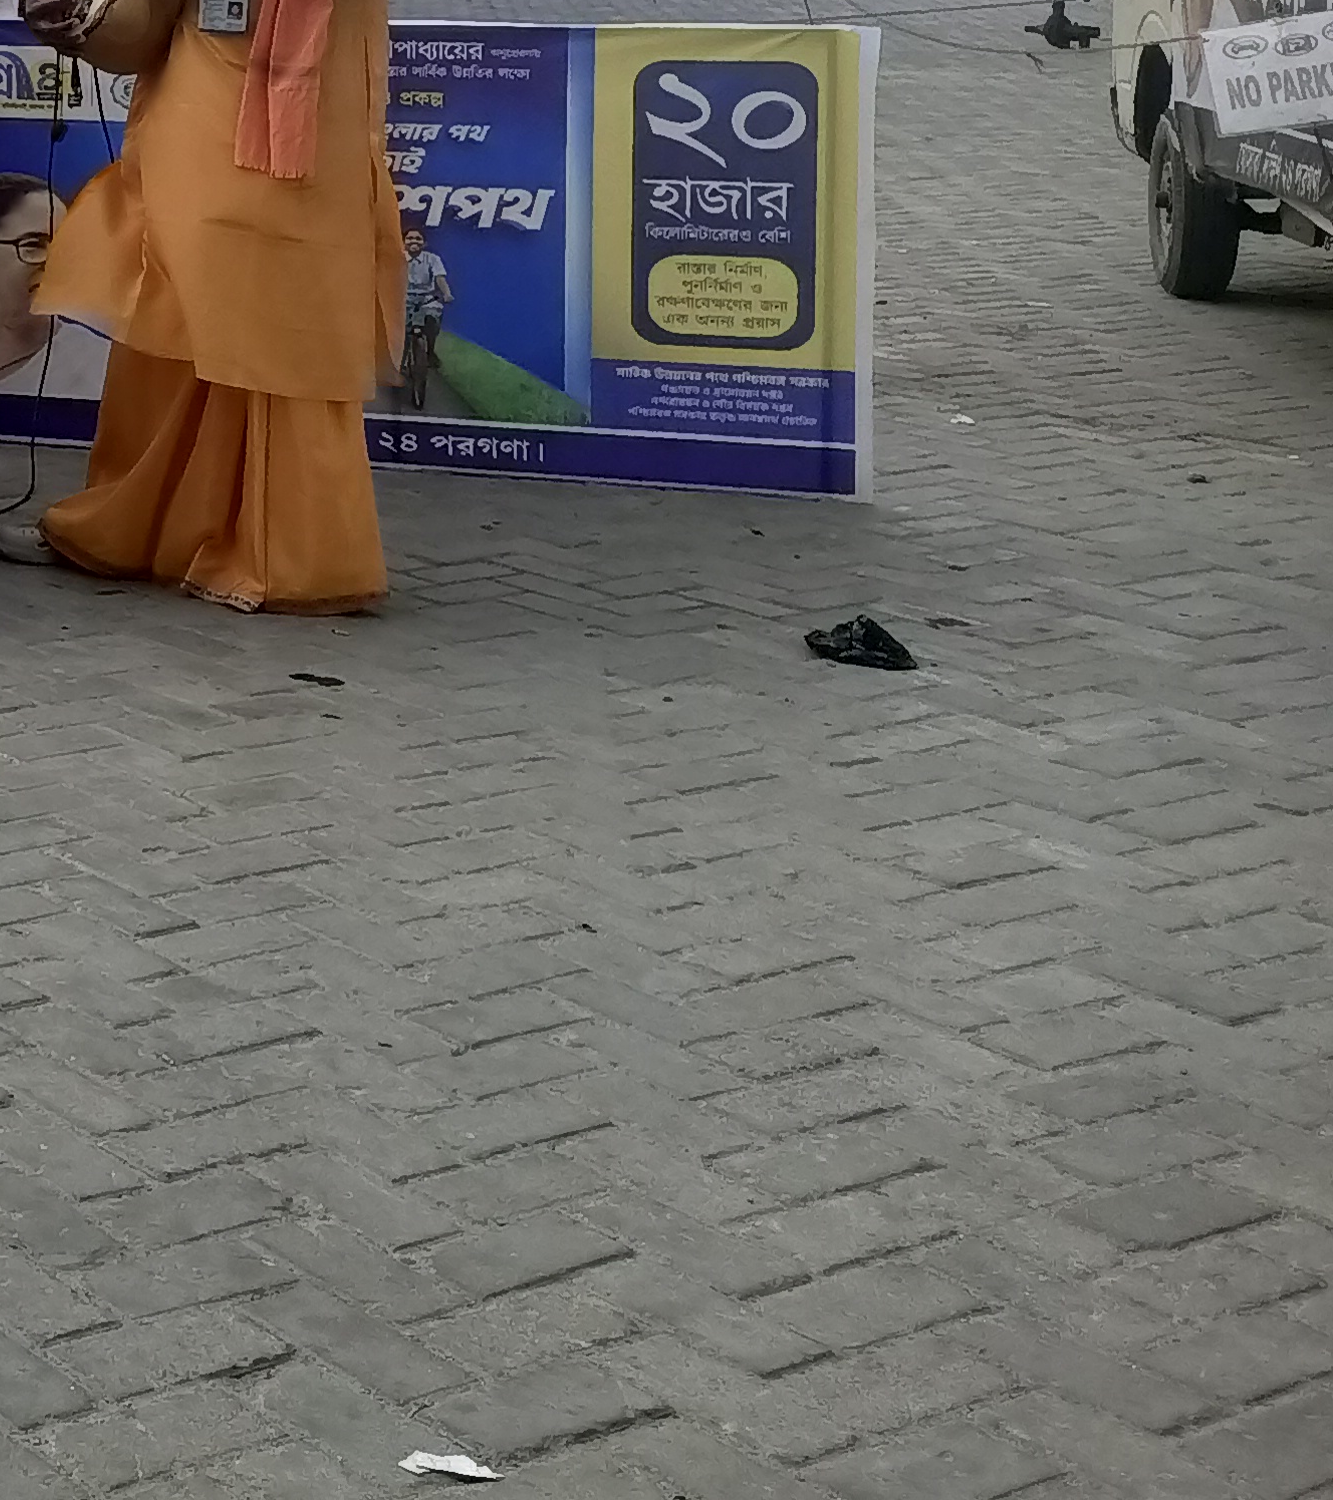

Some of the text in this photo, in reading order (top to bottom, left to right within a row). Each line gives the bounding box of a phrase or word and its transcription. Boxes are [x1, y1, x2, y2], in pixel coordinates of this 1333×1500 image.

[1226, 62, 1333, 110] NO PARK
[448, 124, 491, 142] পথ
[645, 73, 807, 169] ২০
[642, 175, 795, 223] হাজার
[645, 222, 792, 244] কিলোমিটারেরও বেশি
[378, 432, 418, 453] ২৪
